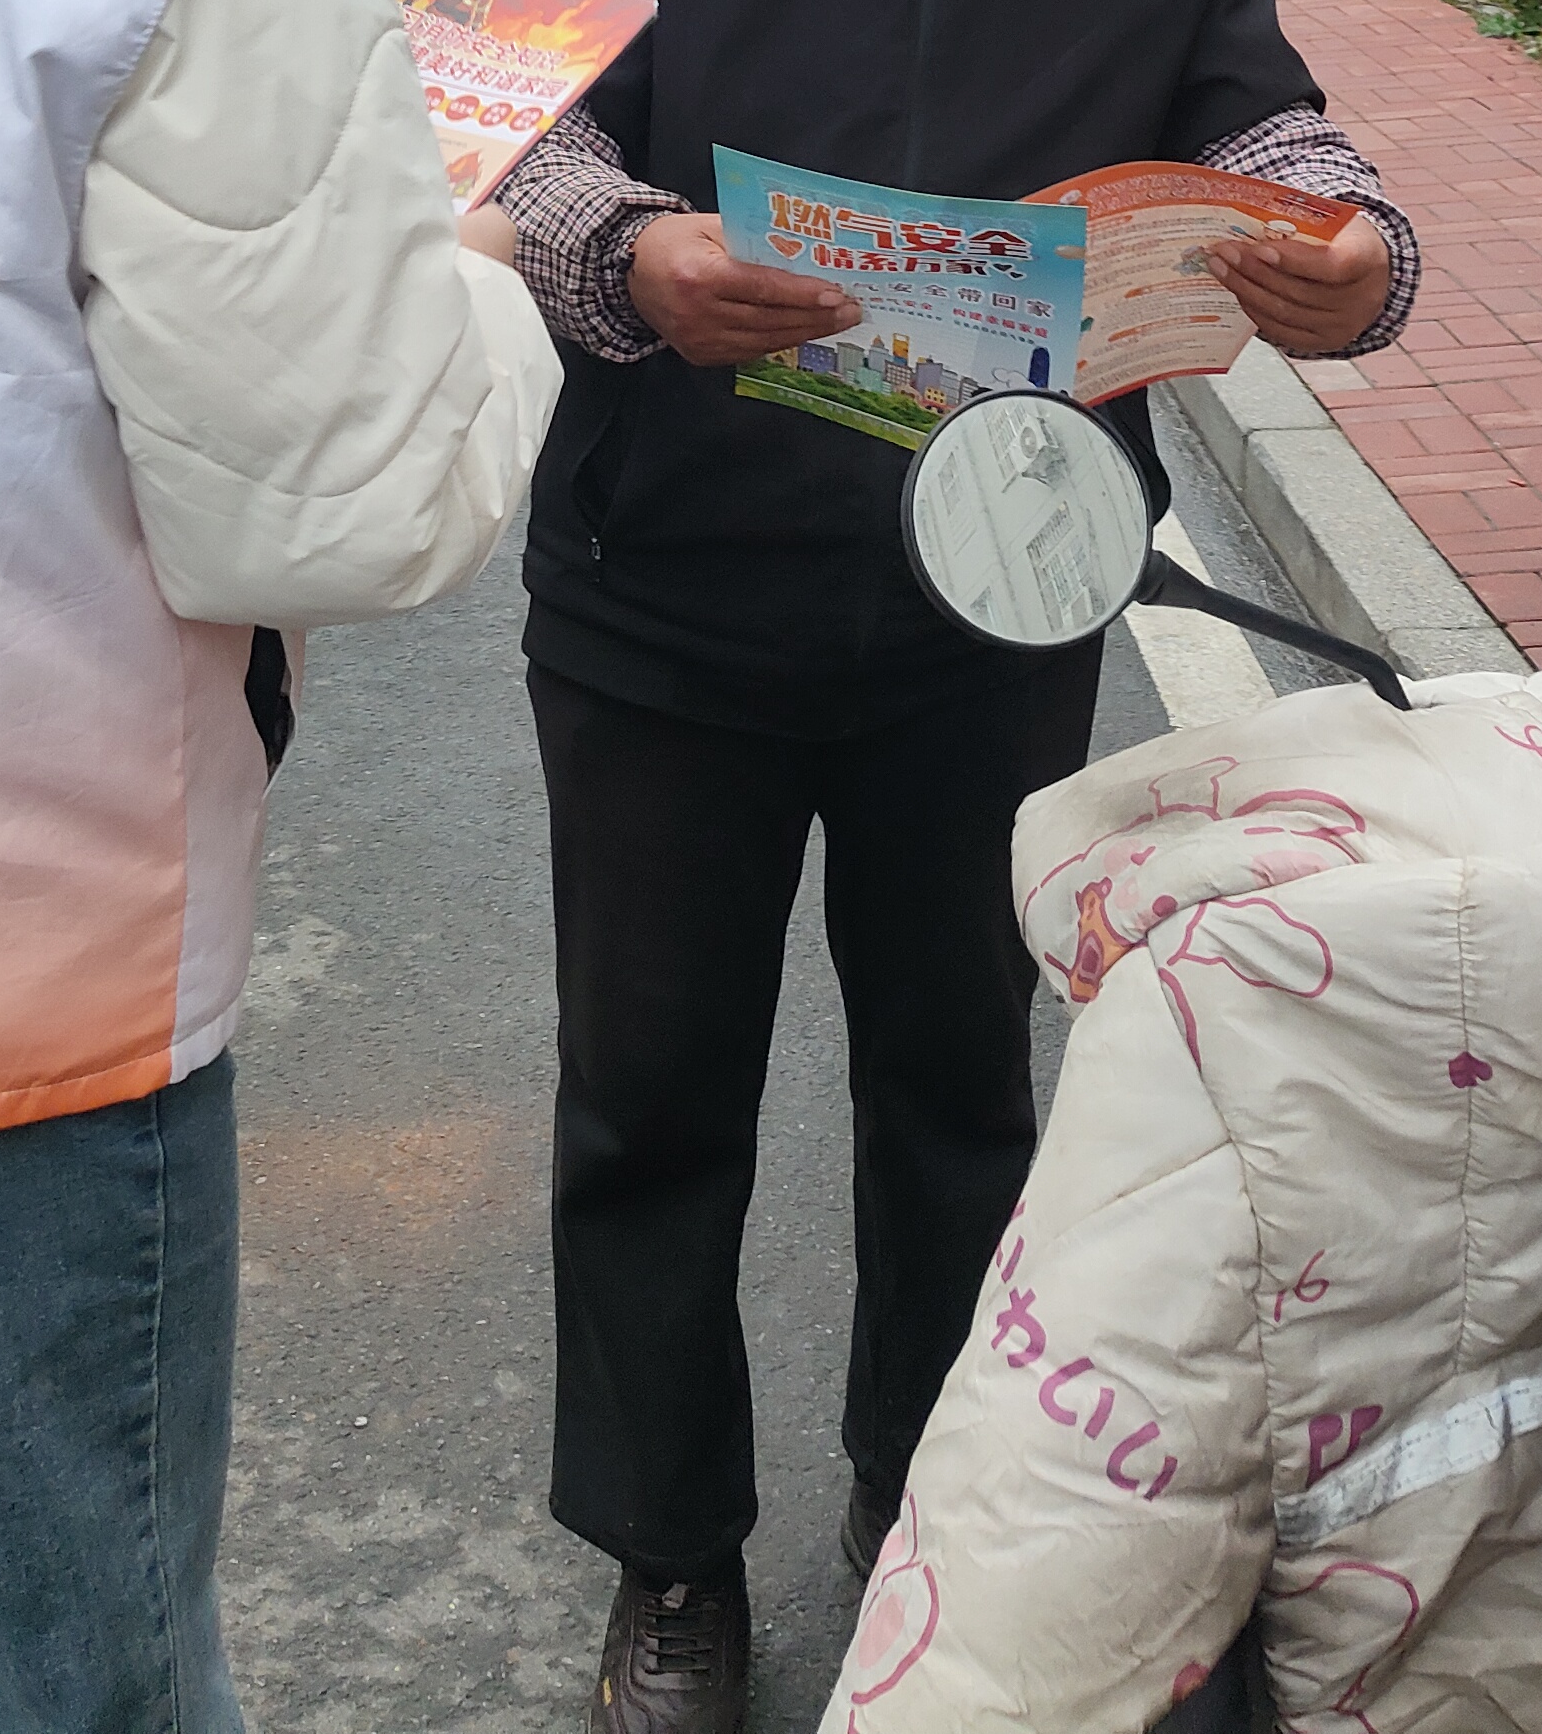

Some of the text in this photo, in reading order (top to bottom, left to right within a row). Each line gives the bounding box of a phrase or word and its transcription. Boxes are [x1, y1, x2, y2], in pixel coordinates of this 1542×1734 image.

[770, 192, 1033, 261] 燃气安全
[812, 242, 987, 277] 情系万家
[836, 282, 1054, 317] 气安全带回家
